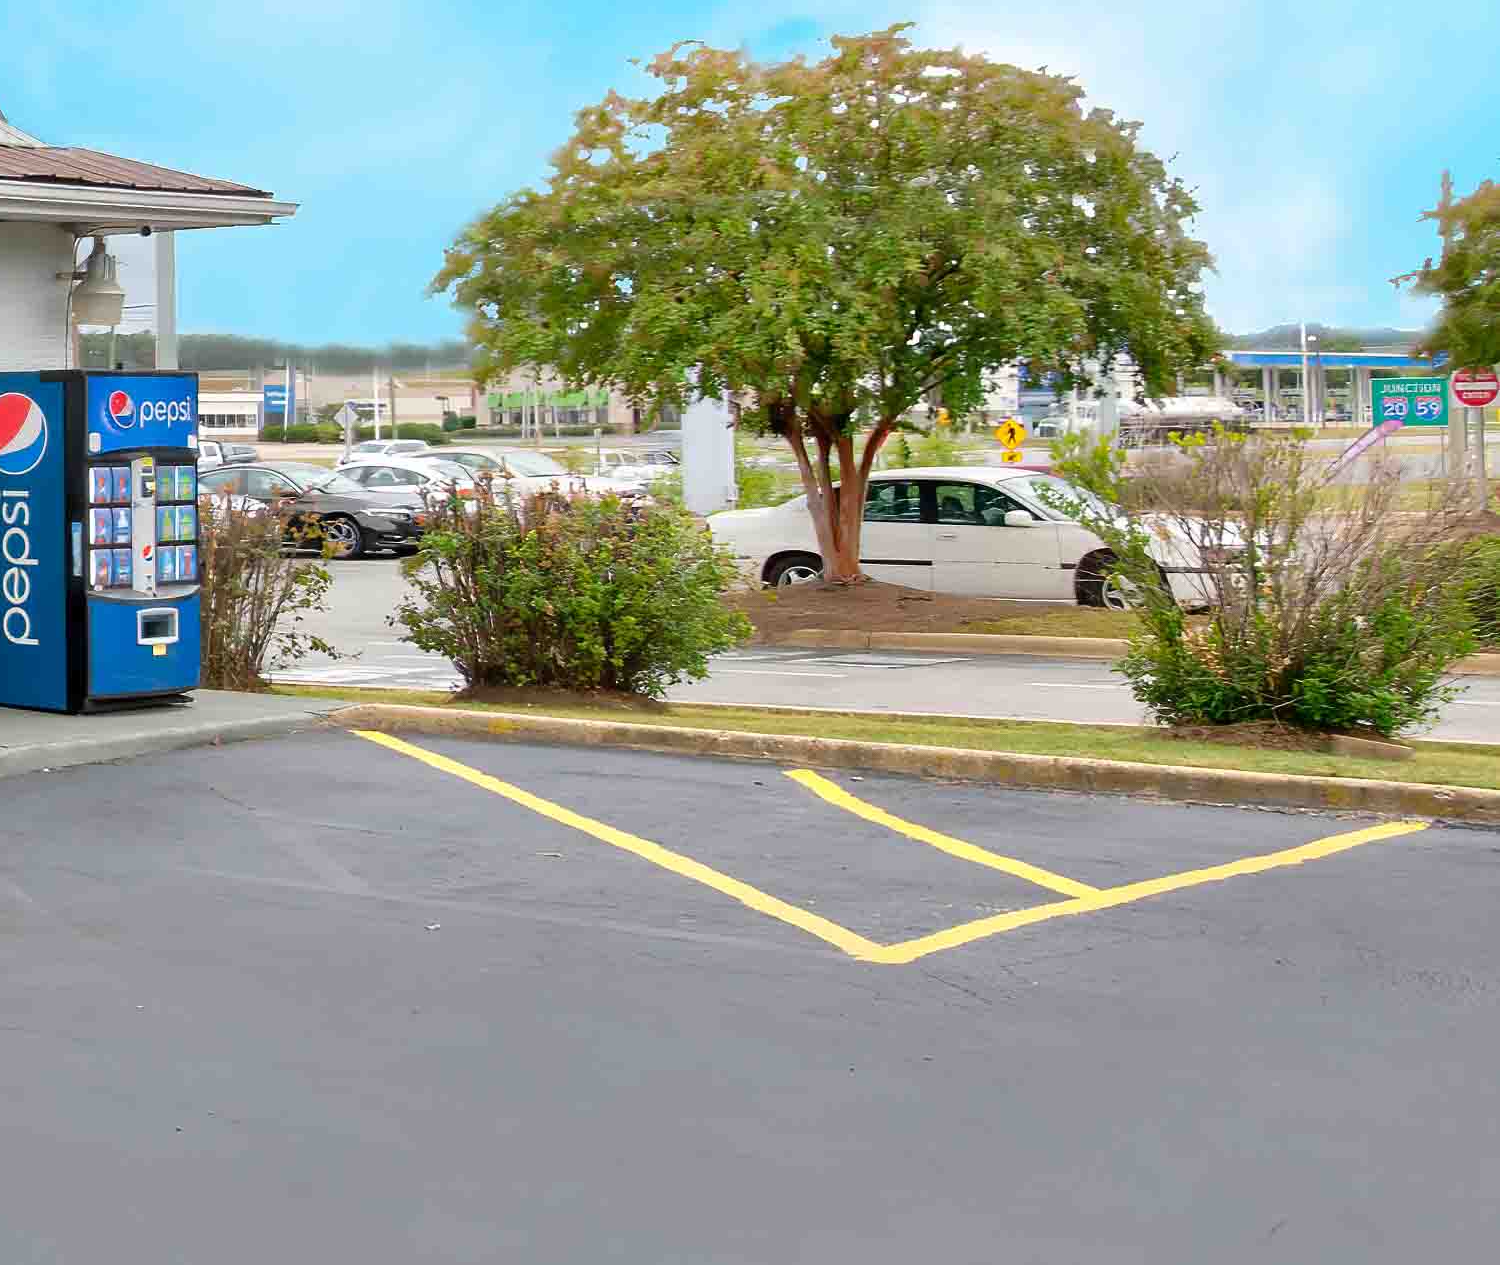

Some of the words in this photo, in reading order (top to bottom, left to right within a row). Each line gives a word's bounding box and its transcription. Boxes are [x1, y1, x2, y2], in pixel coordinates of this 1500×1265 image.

[140, 395, 193, 429] pepsi
[1383, 402, 1406, 416] 20
[1415, 401, 1440, 416] 59
